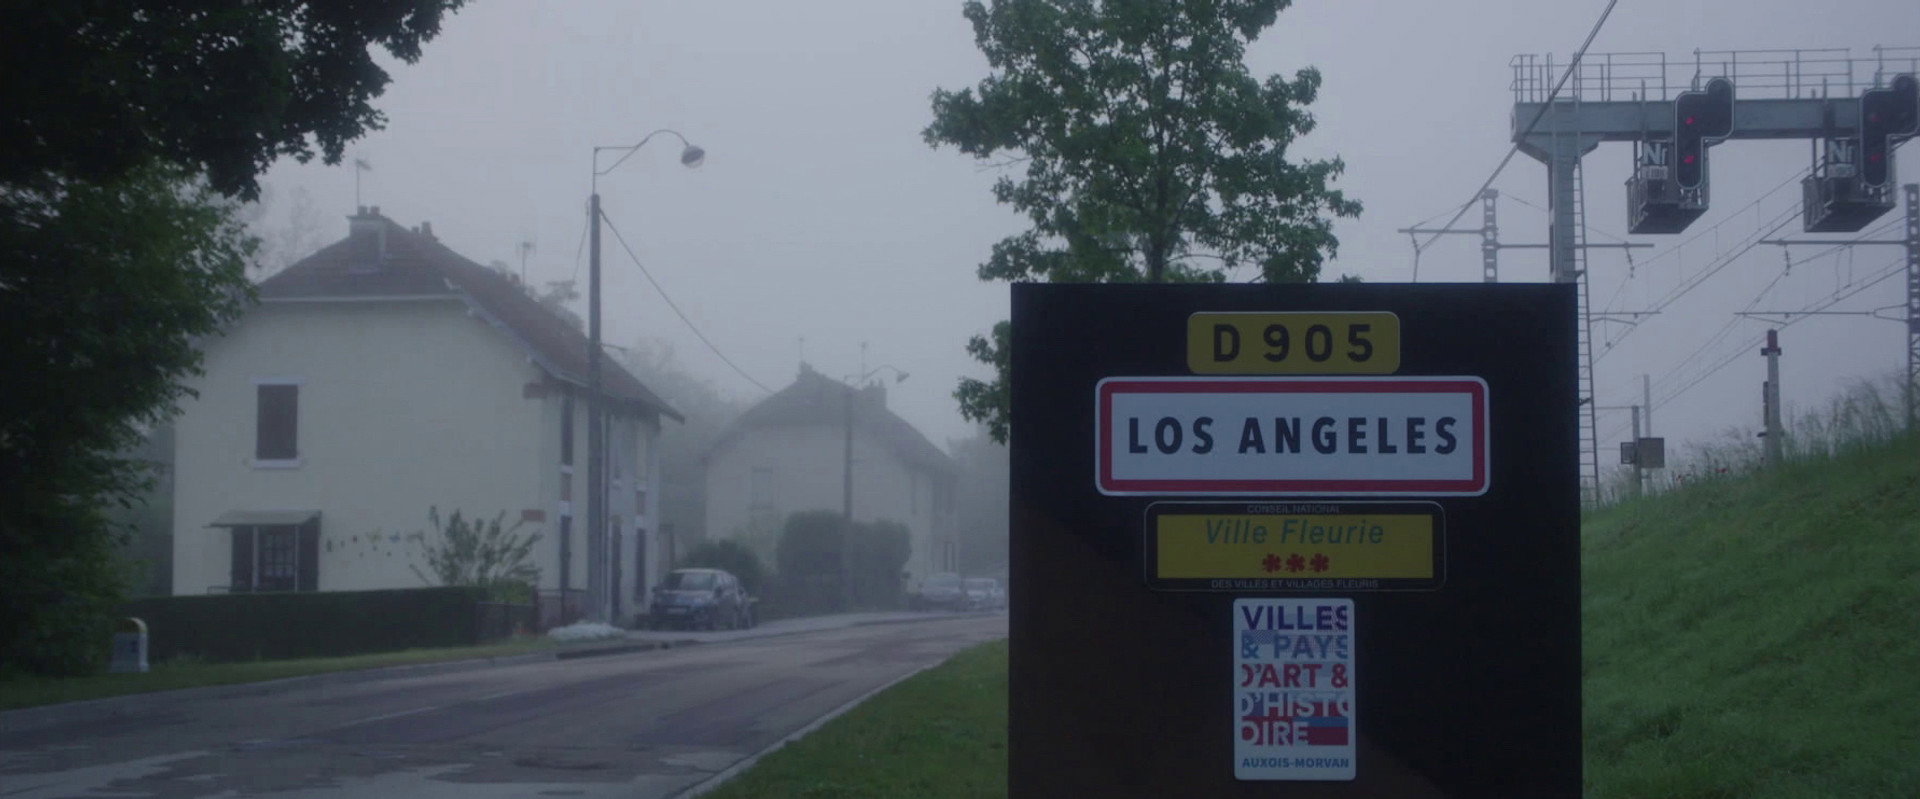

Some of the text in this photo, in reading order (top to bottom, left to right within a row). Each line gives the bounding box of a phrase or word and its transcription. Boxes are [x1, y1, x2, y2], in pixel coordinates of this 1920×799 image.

[1213, 324, 1374, 362] D 905
[1129, 416, 1458, 455] LOS ANGELES
[1247, 504, 1341, 514] CONSEIL NATIONAL
[1206, 518, 1385, 545] Ville Fleurie
[1211, 579, 1379, 589] DES VILLES ET VILLAGES FLEURIS
[1241, 605, 1348, 630] VILLES
[1241, 634, 1348, 659] & PAYS
[1331, 663, 1348, 688] &
[1242, 757, 1349, 769] AUXOIS-MORVAN
